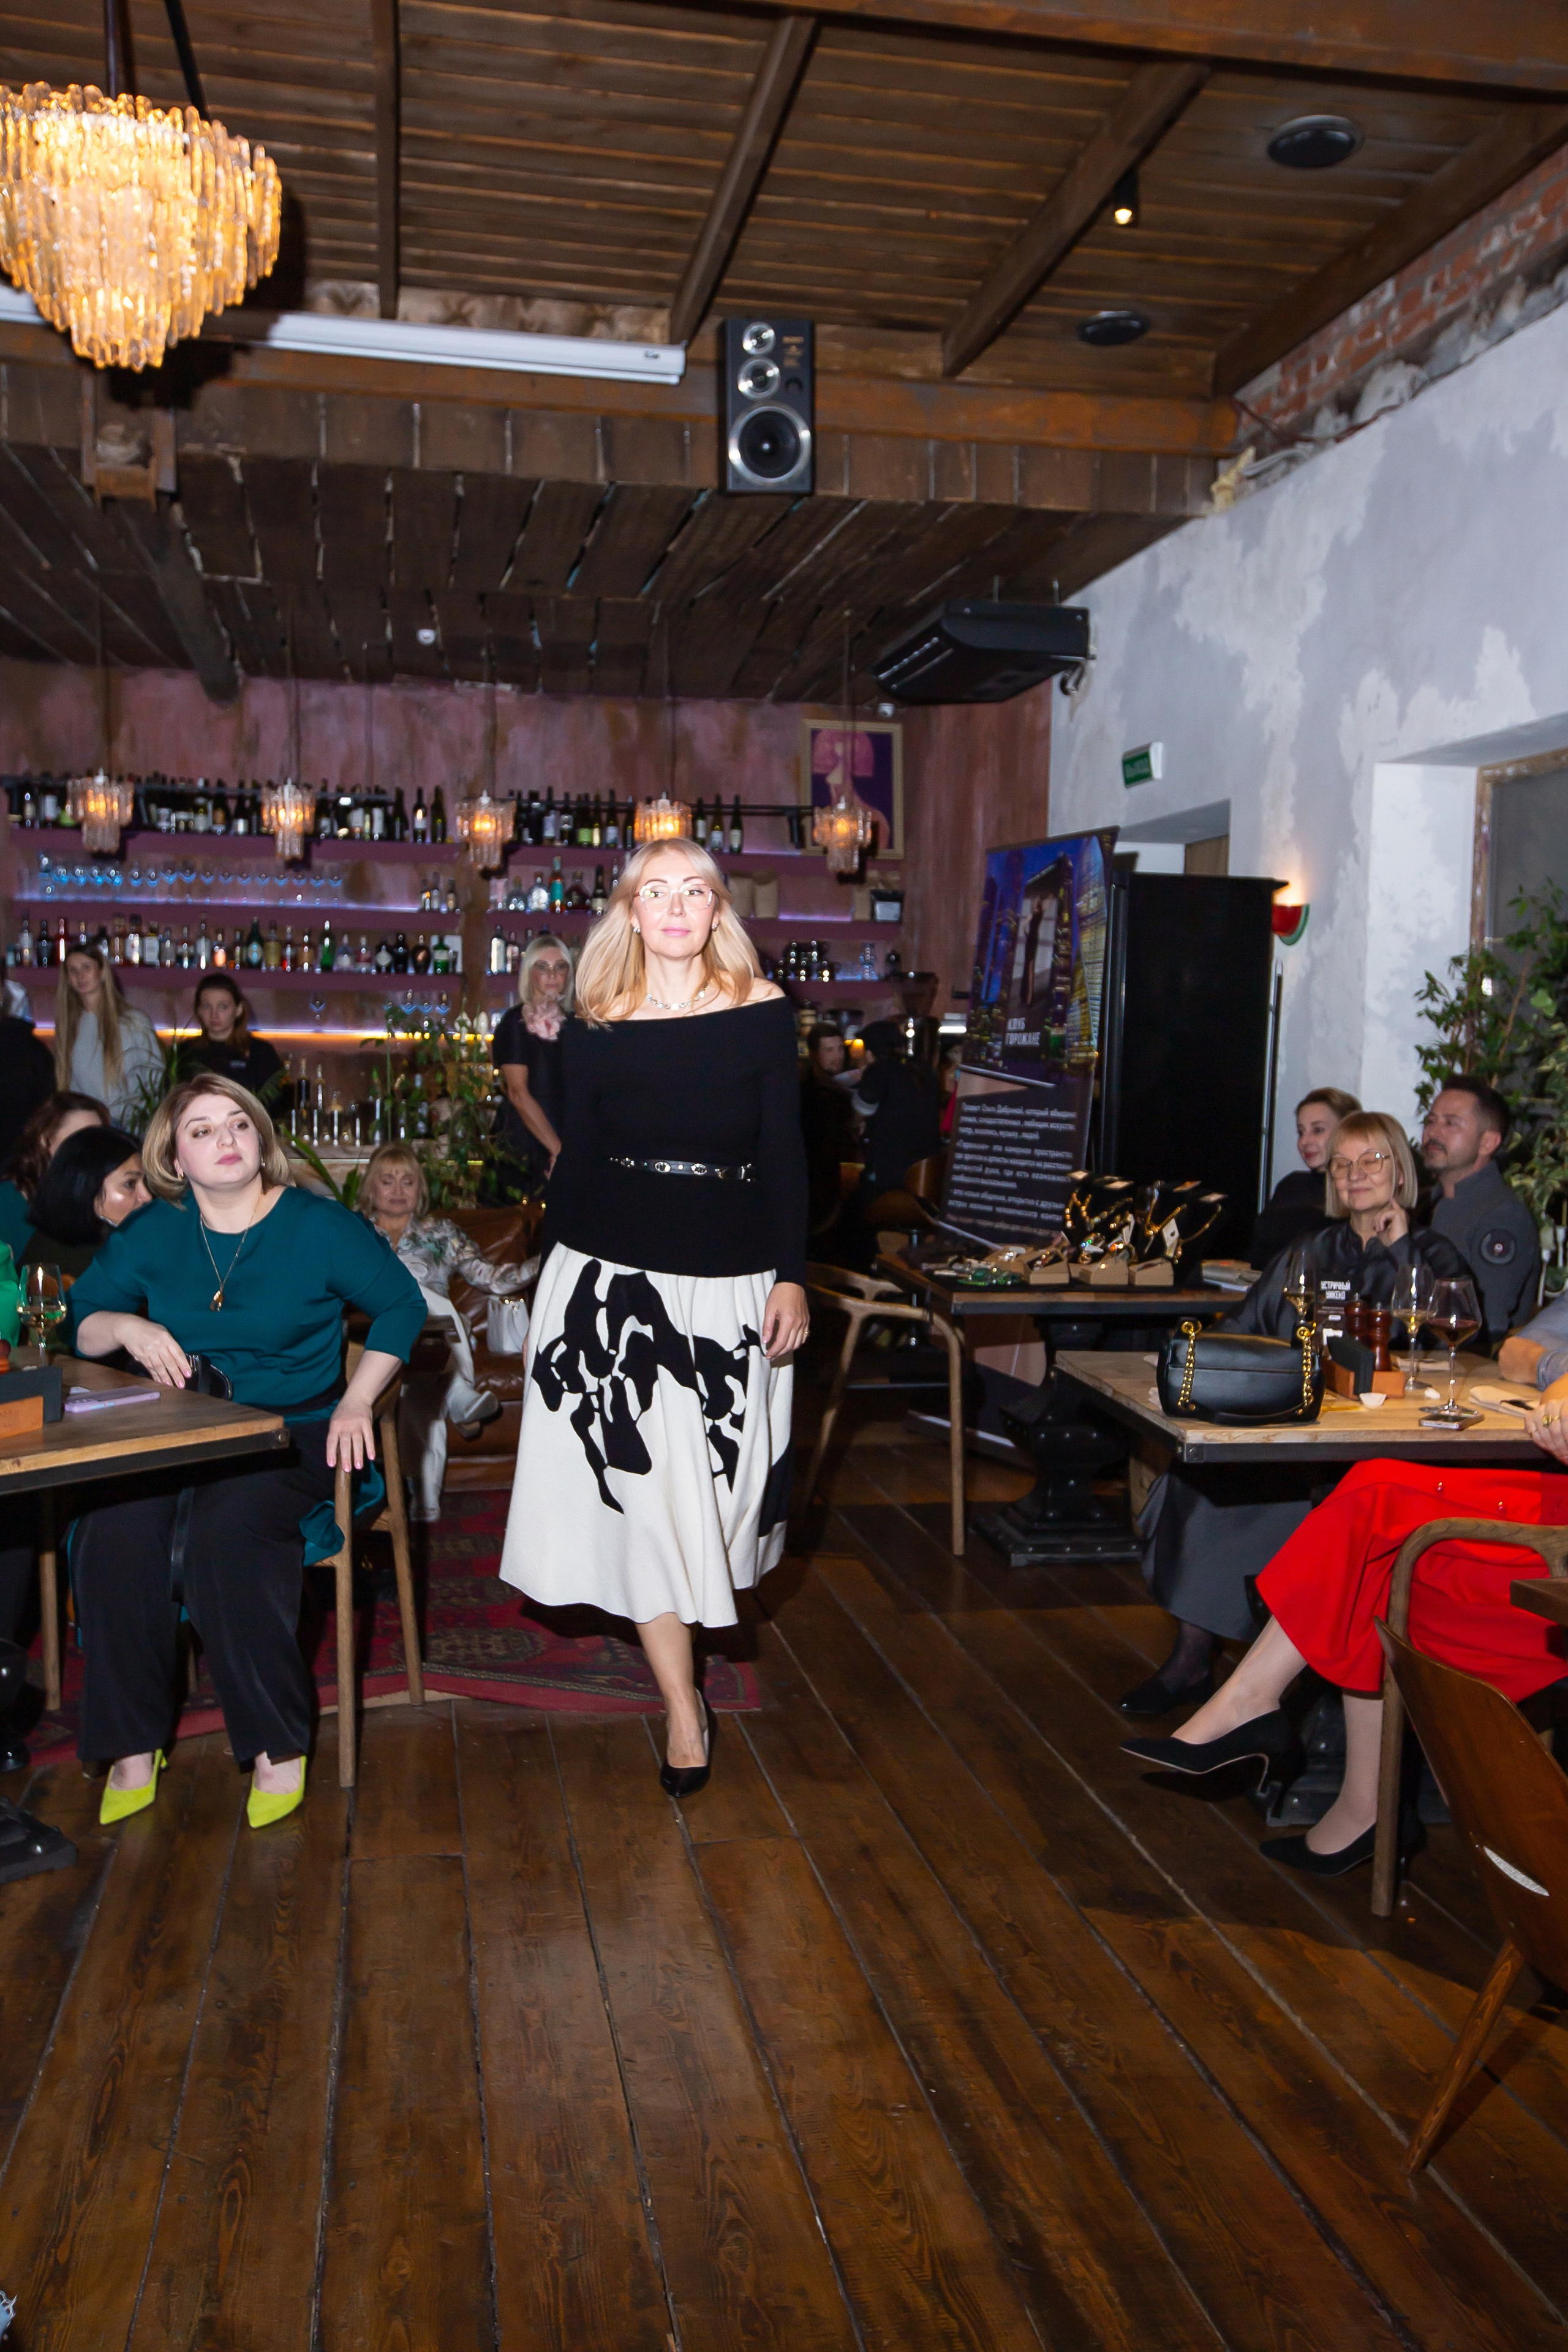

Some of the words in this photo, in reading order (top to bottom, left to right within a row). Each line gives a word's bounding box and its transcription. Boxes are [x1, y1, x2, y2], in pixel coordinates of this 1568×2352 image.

[1005, 1032, 1041, 1047] ГОРОЖАНЕ
[1321, 1280, 1351, 1291] УСТРИЧНЫЙ
[1325, 1290, 1346, 1300] УИКЕНД
